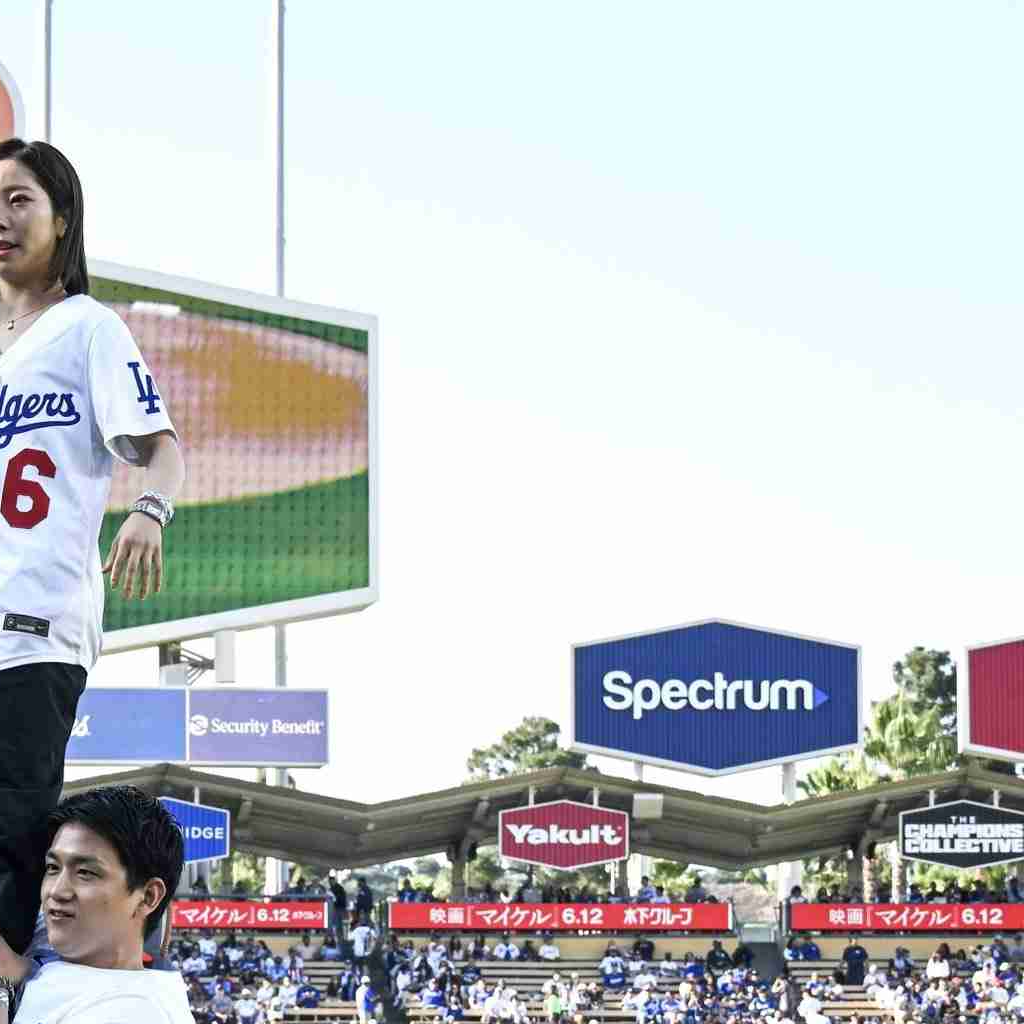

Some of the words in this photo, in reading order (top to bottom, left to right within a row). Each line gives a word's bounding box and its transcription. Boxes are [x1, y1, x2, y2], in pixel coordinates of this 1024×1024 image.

[127, 362, 160, 414] LA
[0, 448, 56, 529] 6
[602, 670, 813, 719] Spectrum
[211, 718, 269, 737] Security
[272, 719, 321, 735] Benefit
[950, 815, 976, 824] THE
[505, 824, 623, 845] Yakult
[904, 823, 1024, 838] CHAMPIONS
[904, 838, 1024, 853] COLLECTIVE
[256, 908, 291, 922] 6.12
[561, 909, 603, 925] 6.12
[961, 908, 1003, 925] 6.12
